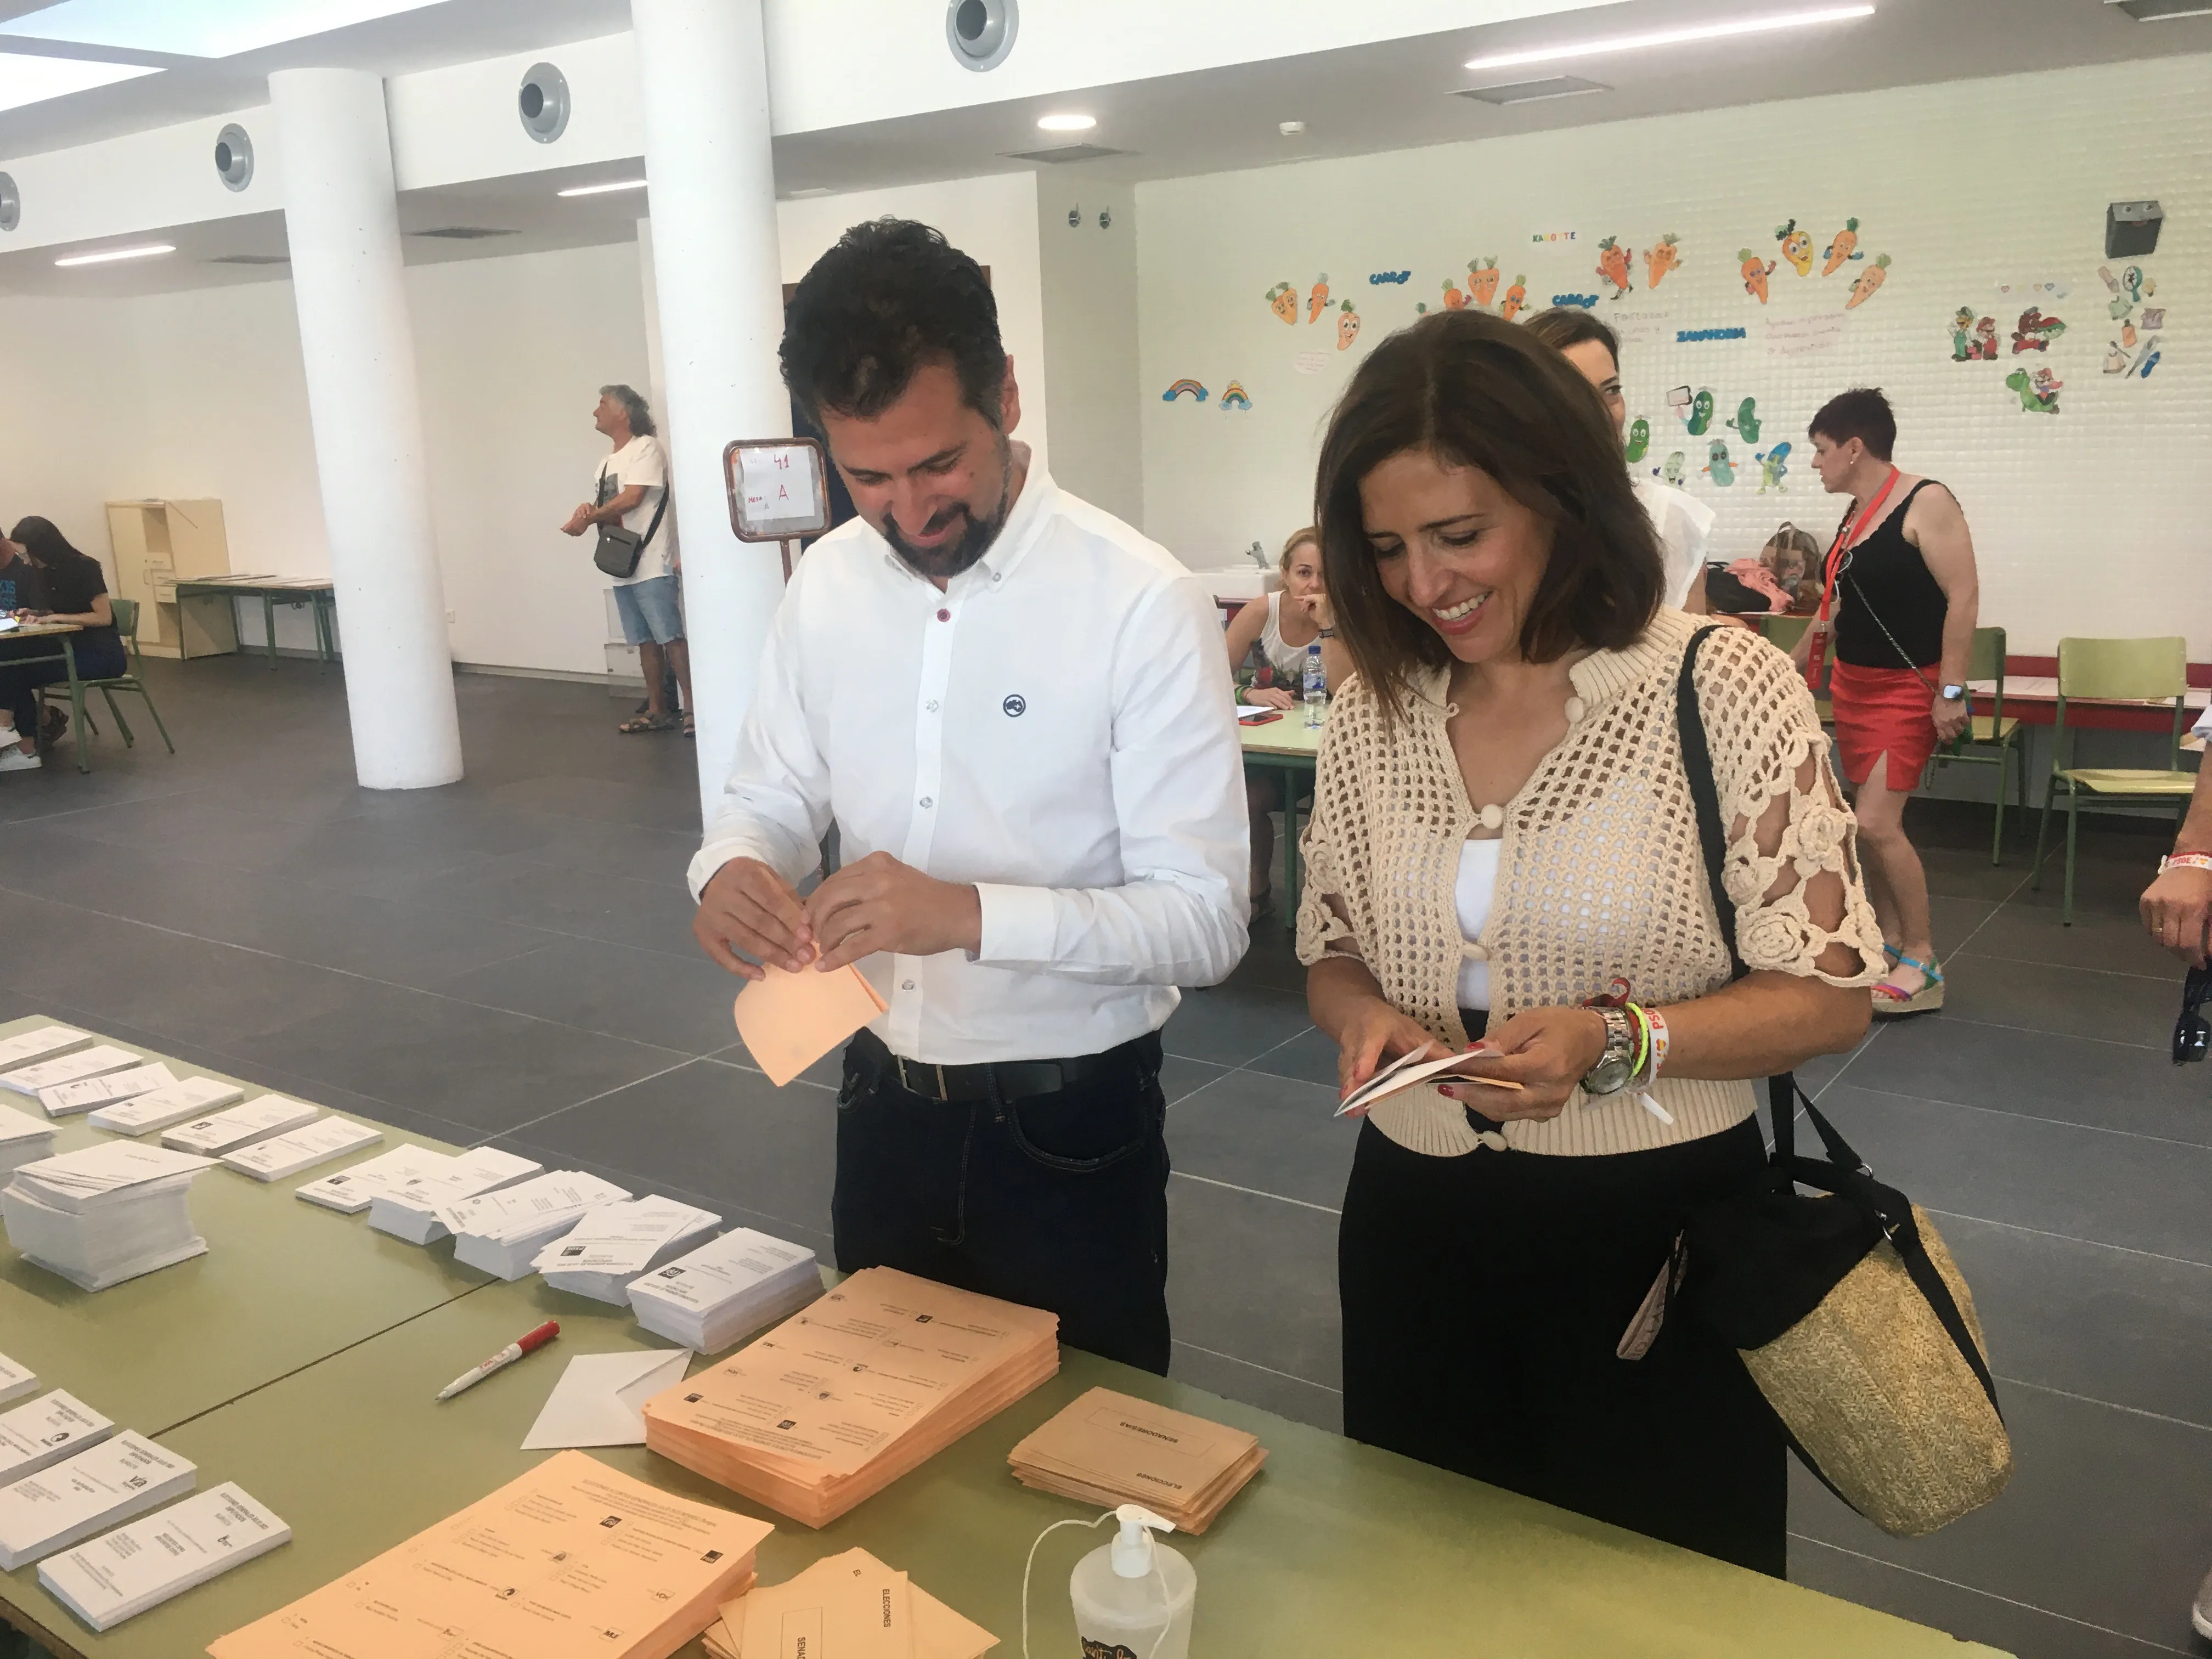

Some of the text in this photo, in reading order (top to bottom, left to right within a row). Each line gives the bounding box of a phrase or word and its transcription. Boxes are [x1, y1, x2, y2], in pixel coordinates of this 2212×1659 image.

[774, 454, 789, 470] 41
[778, 484, 789, 500] A
[1136, 1472, 1182, 1489] ELECCIONES
[882, 1589, 891, 1628] ELECCIONES
[604, 1630, 618, 1639] MJ
